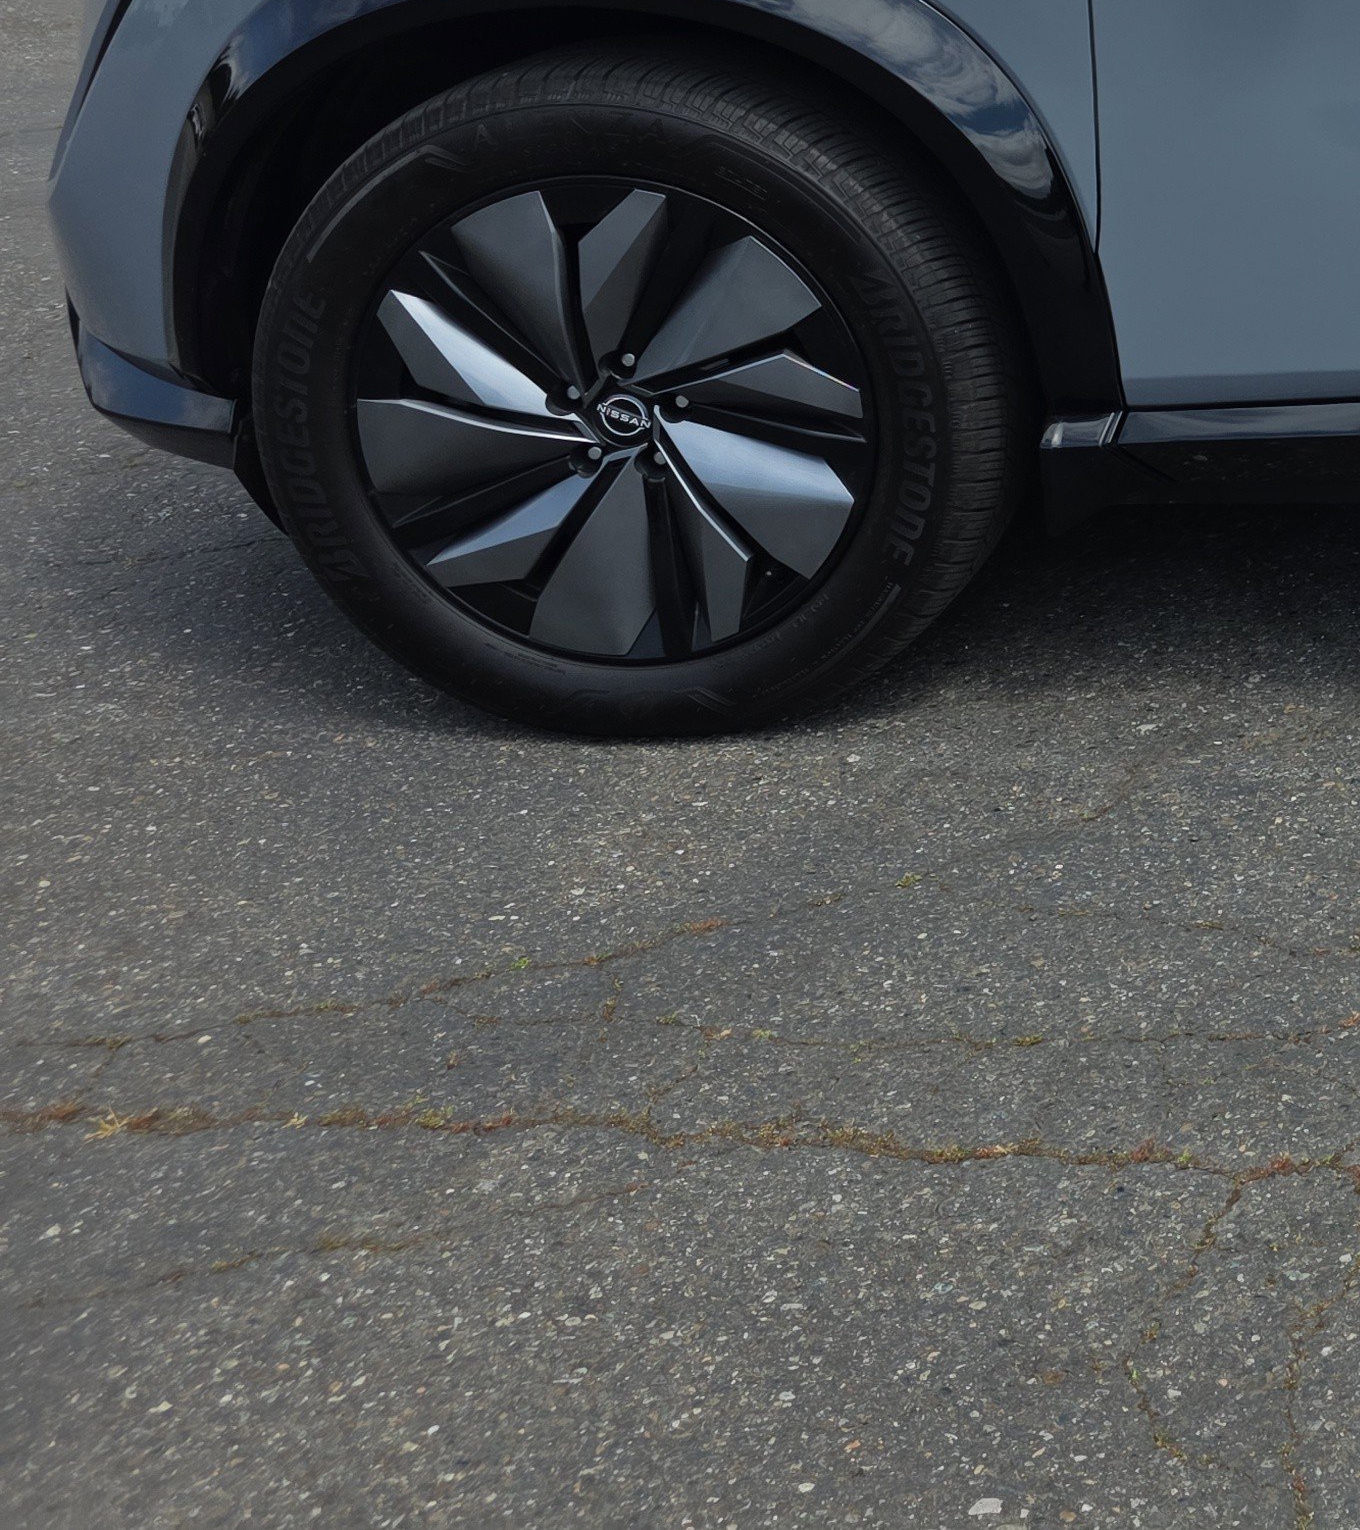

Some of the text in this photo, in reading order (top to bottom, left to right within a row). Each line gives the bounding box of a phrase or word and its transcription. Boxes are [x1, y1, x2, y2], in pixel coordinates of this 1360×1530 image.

[272, 288, 370, 582] BRIDGESTONE
[597, 403, 651, 429] NISSAN
[846, 272, 938, 567] BRIDGESTONE
